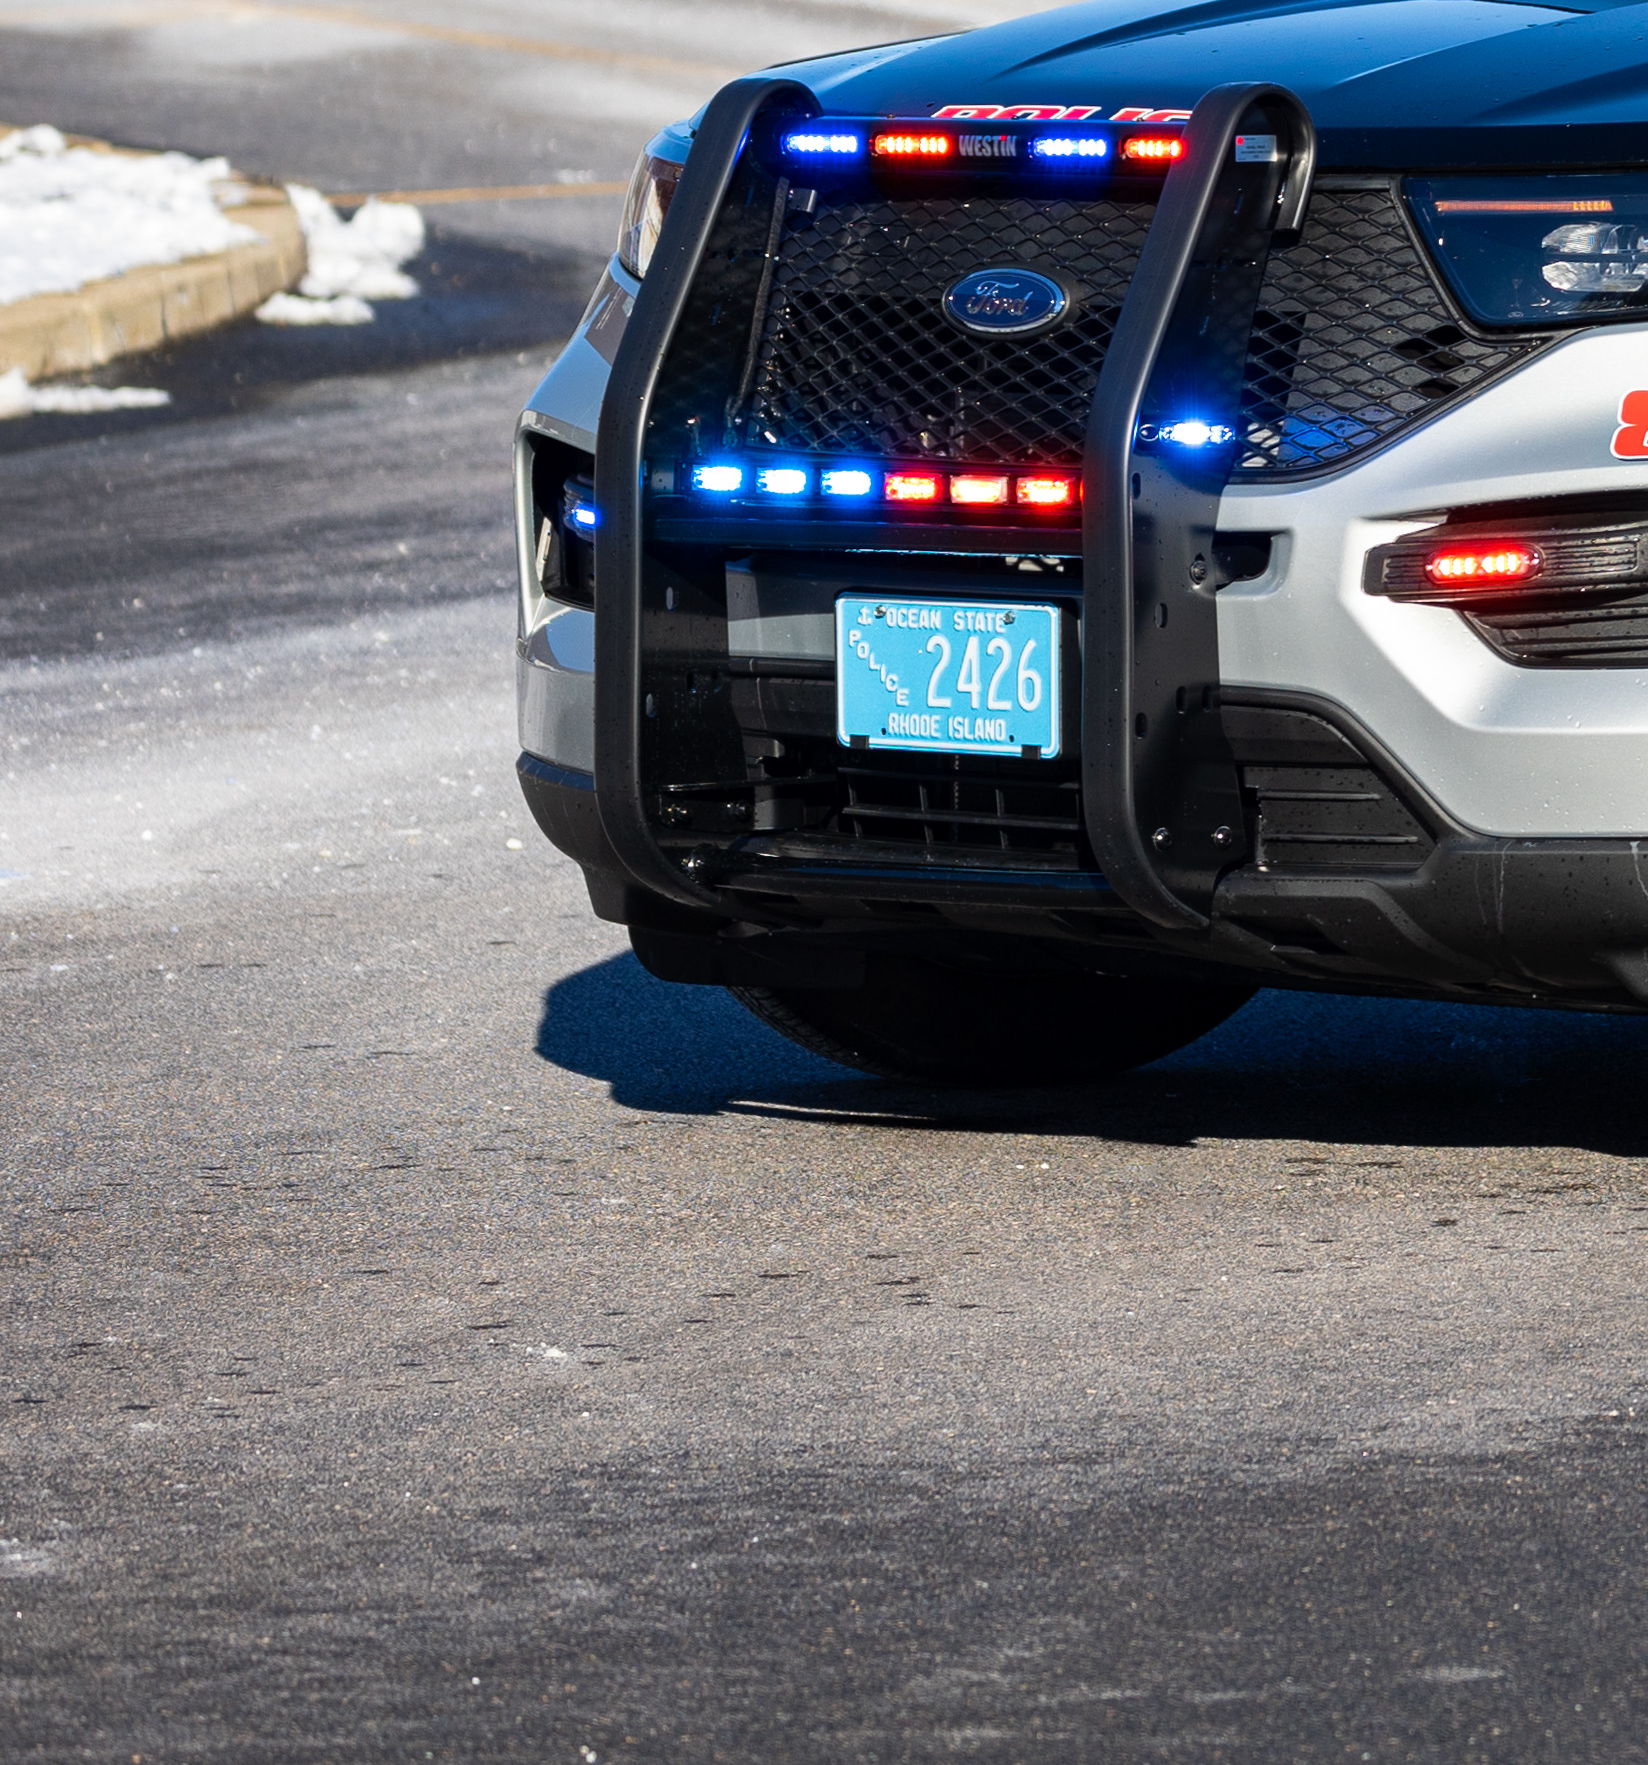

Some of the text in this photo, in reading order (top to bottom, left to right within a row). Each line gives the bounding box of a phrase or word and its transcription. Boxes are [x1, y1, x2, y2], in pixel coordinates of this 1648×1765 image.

[885, 607, 1008, 633] OCEAN STATE
[848, 629, 910, 707] POLICE
[925, 634, 1043, 712] 2426
[887, 712, 1007, 742] RHODE ISLAND
